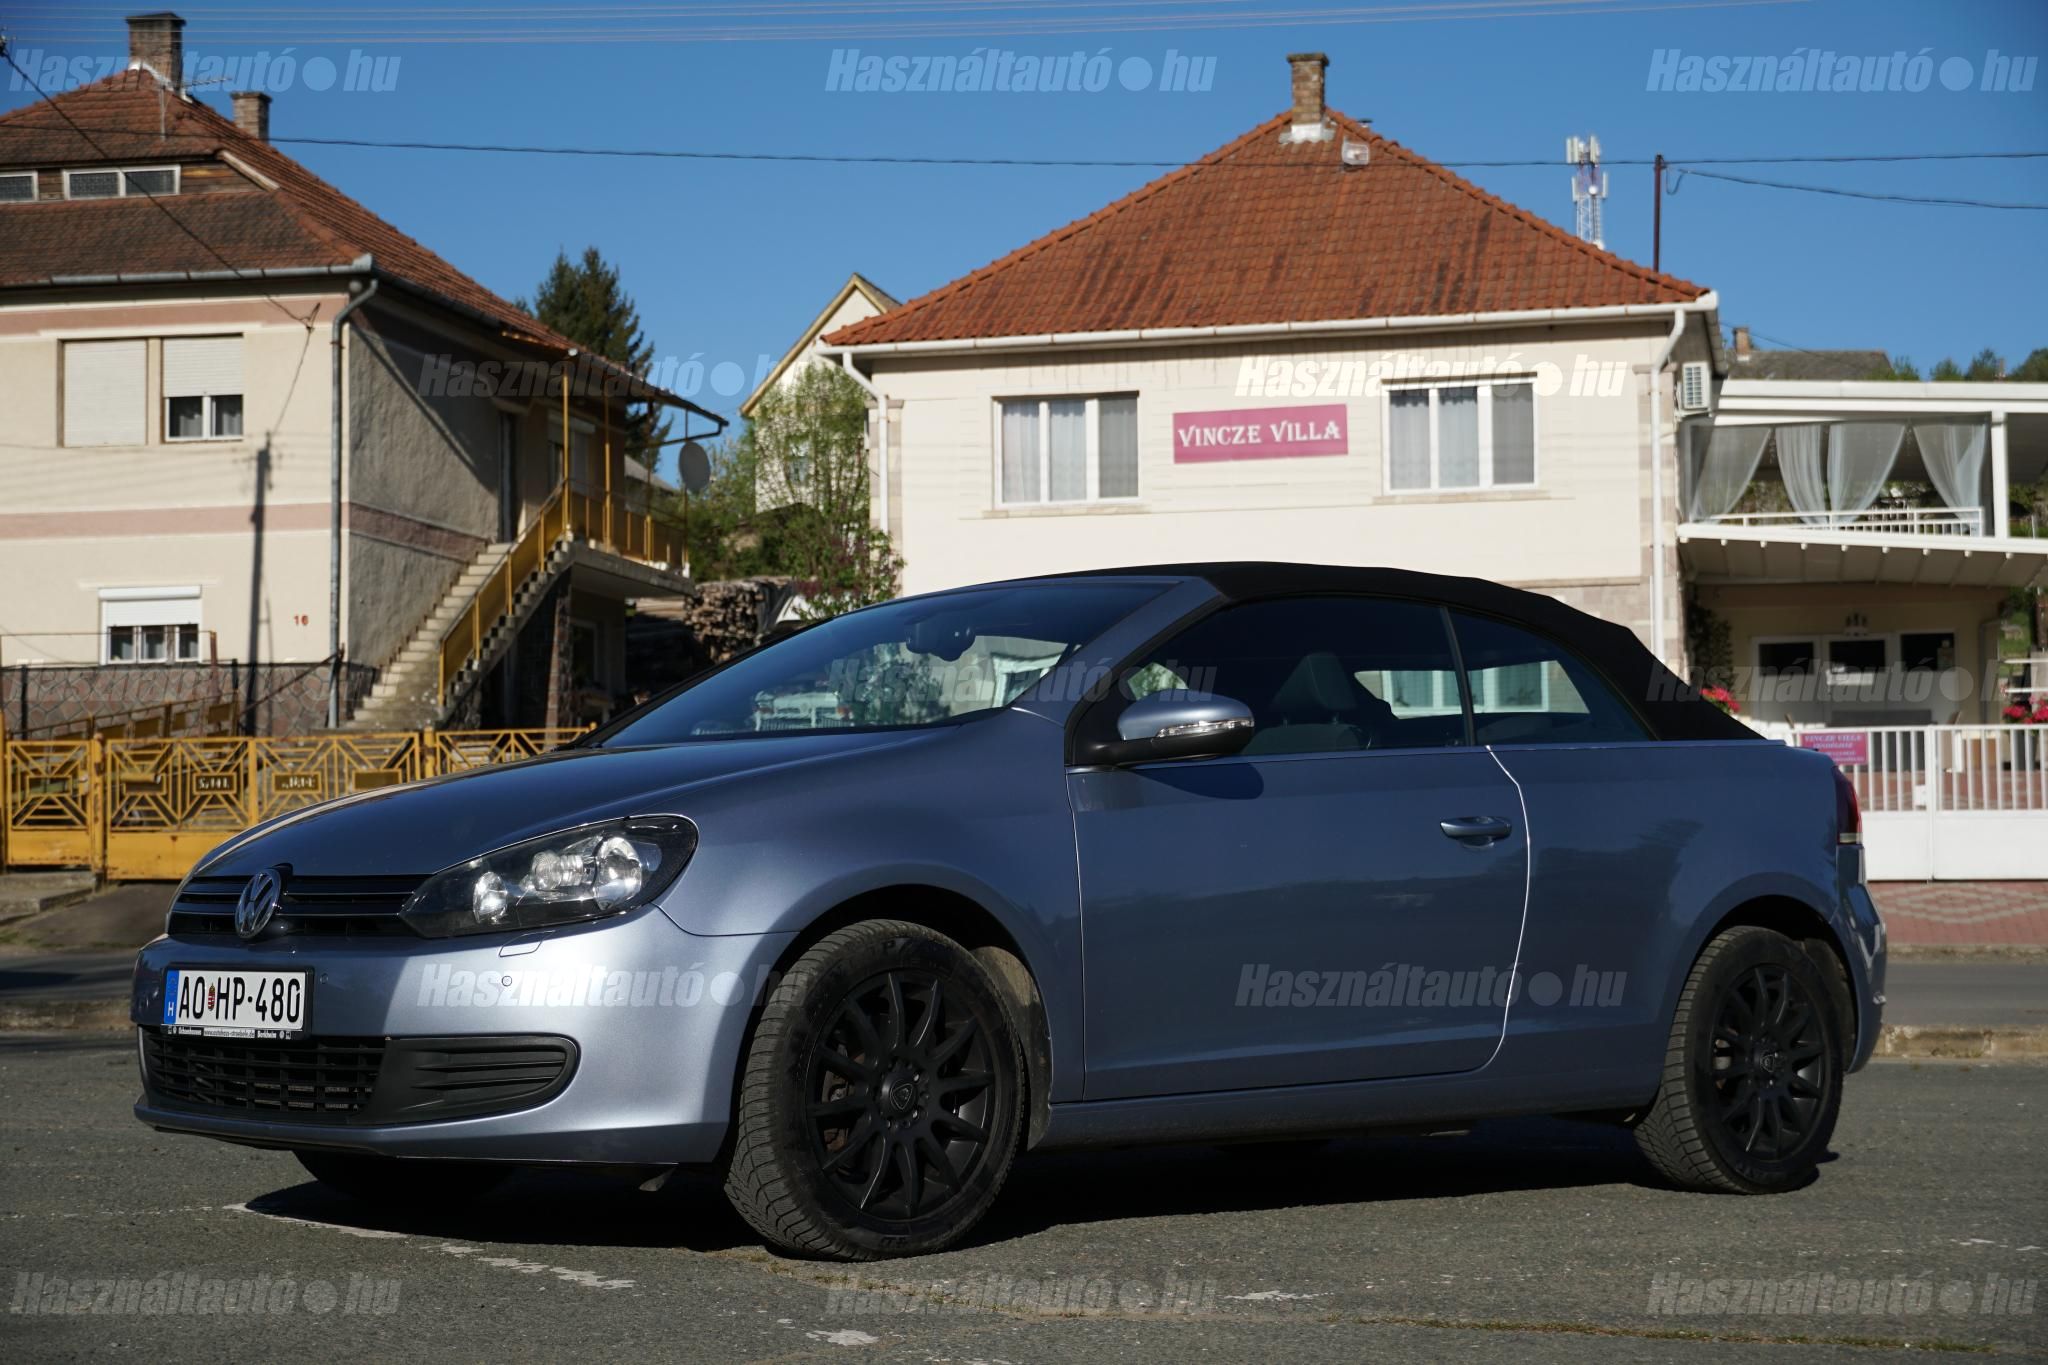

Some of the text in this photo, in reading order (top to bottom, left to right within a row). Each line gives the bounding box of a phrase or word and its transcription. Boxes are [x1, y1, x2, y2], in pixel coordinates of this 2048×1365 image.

[1178, 420, 1341, 447] VINCZE VILLA
[294, 615, 309, 626] 16
[178, 976, 206, 1020] AO
[167, 1001, 174, 1017] H
